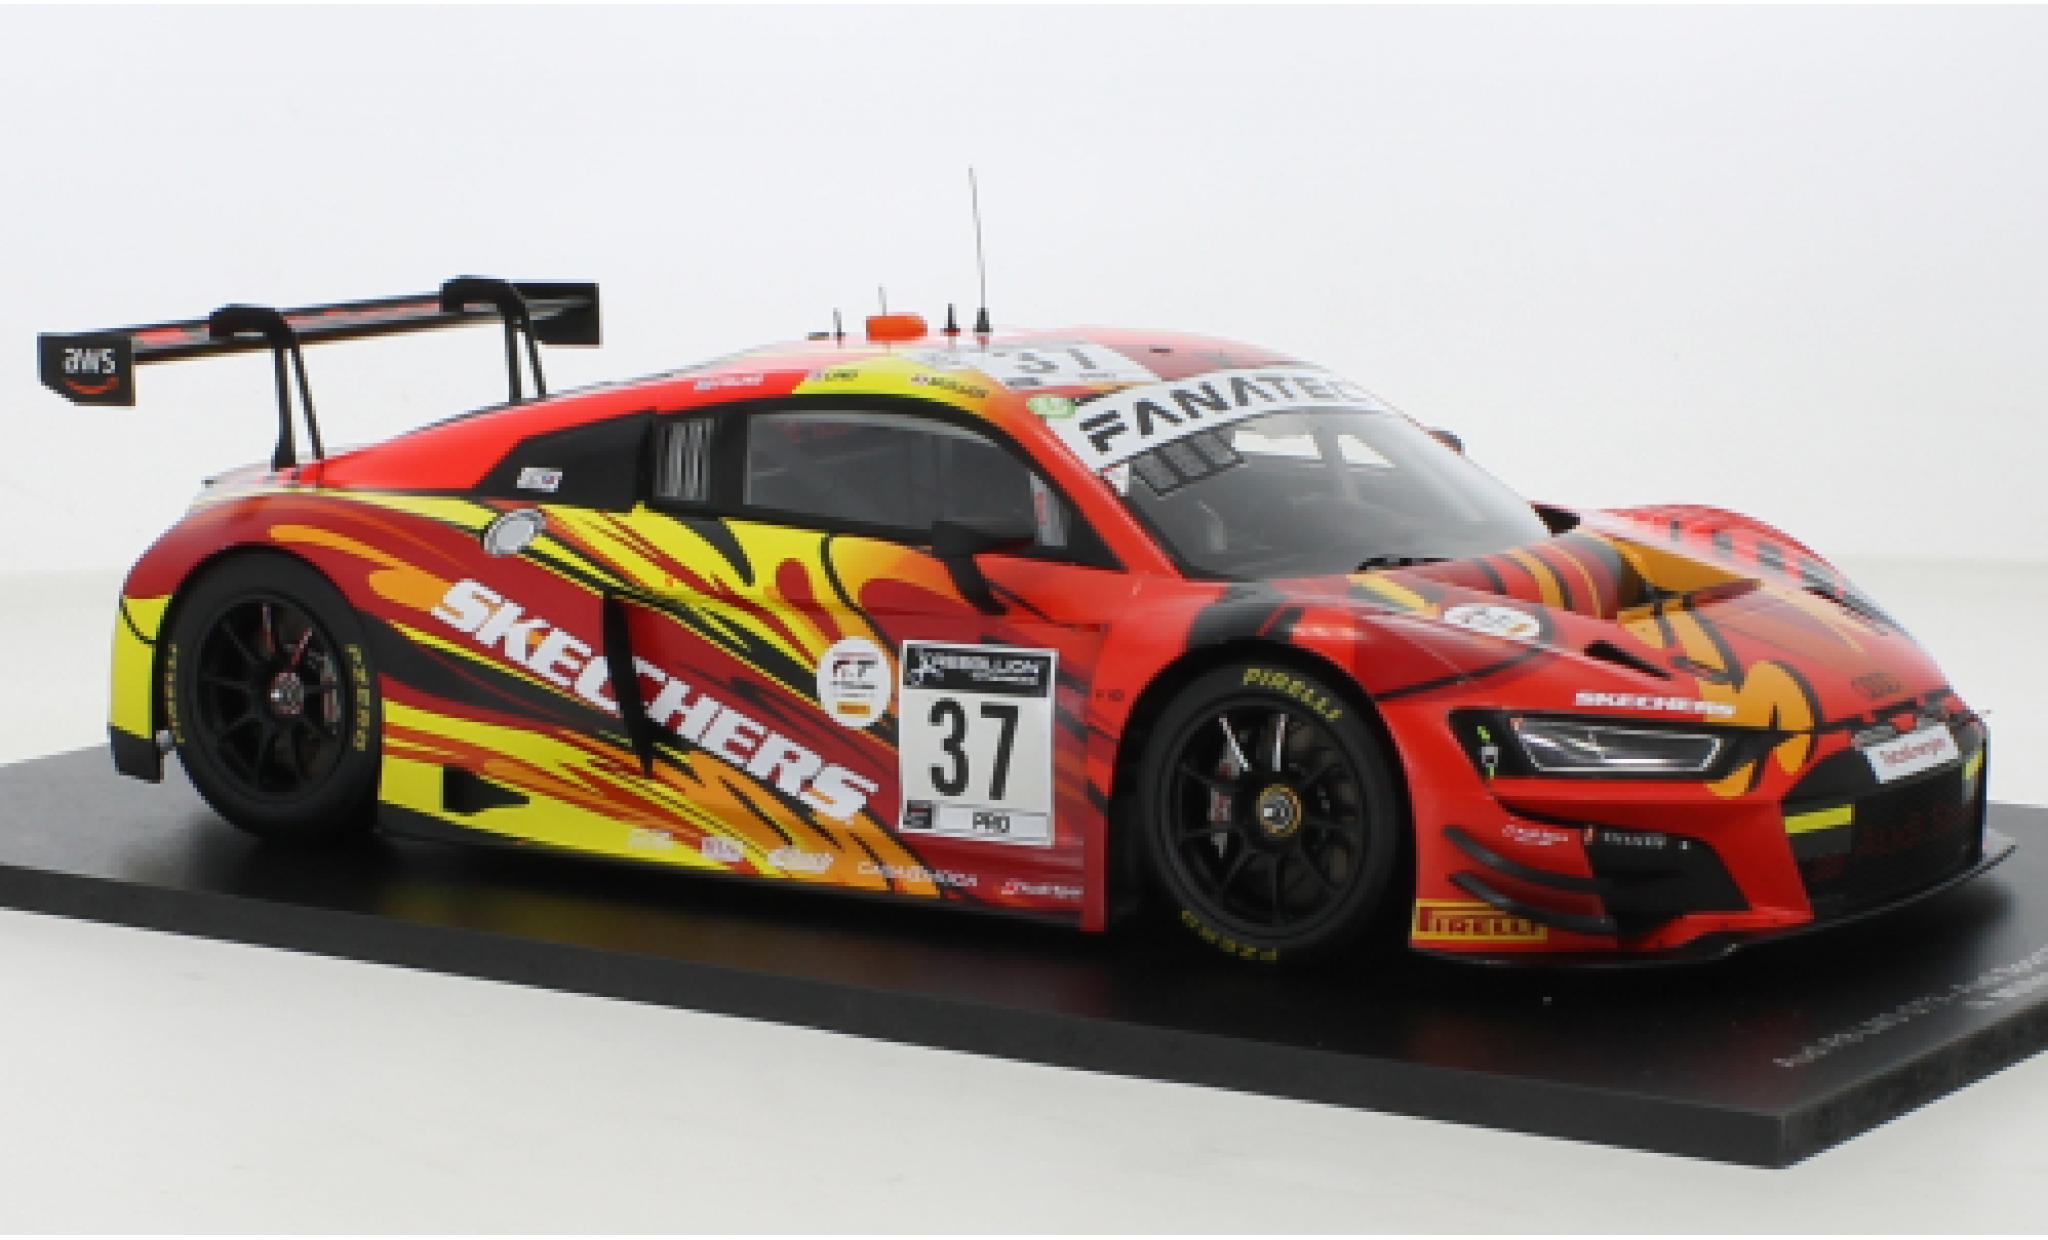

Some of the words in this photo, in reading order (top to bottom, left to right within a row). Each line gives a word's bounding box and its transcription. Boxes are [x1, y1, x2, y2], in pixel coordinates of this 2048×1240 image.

[61, 347, 117, 375] aws
[430, 578, 879, 826] SKECHERS
[1242, 667, 1343, 719] PIRELLI
[1574, 690, 1736, 717] SKECHERS
[927, 696, 1020, 801] 37
[972, 812, 1011, 835] PRO
[1419, 905, 1538, 935] PIRELLI
